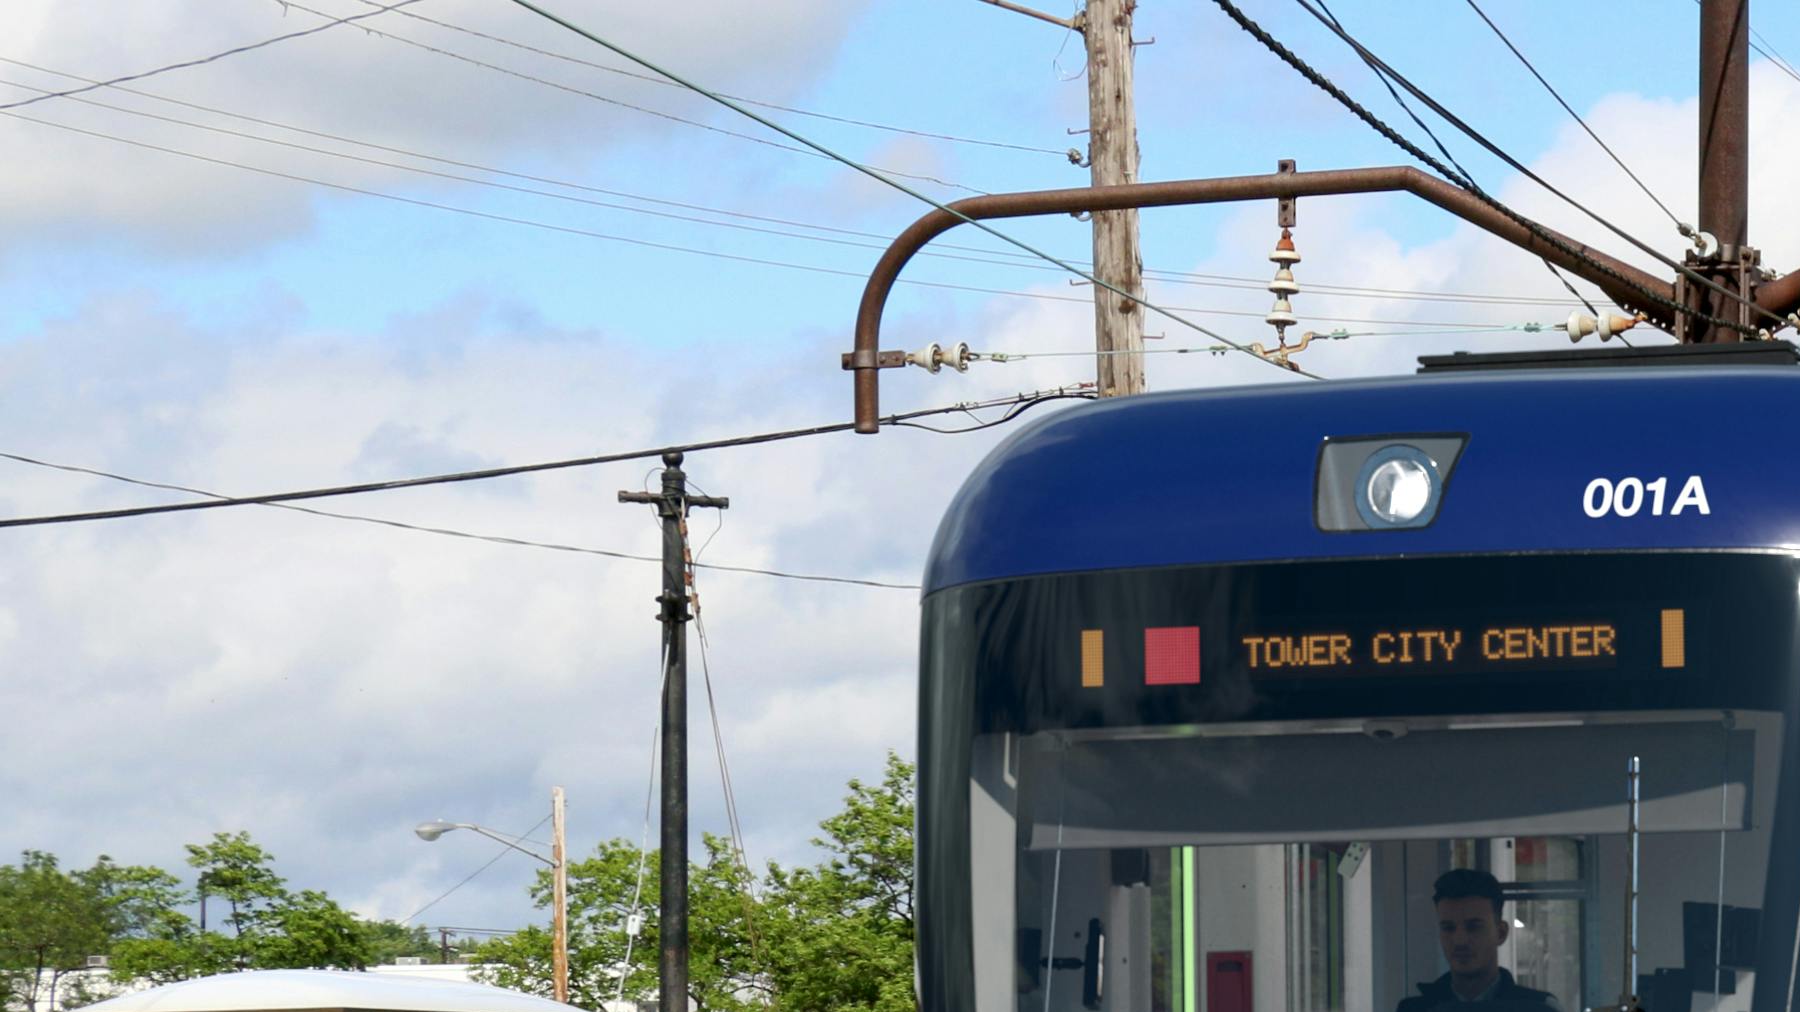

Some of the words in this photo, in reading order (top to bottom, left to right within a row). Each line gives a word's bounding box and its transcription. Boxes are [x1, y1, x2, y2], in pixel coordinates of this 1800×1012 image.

[1583, 475, 1711, 518] 001A
[1242, 633, 1353, 668] TOWER
[1372, 630, 1462, 664] CITY
[1482, 625, 1617, 660] CENTER
